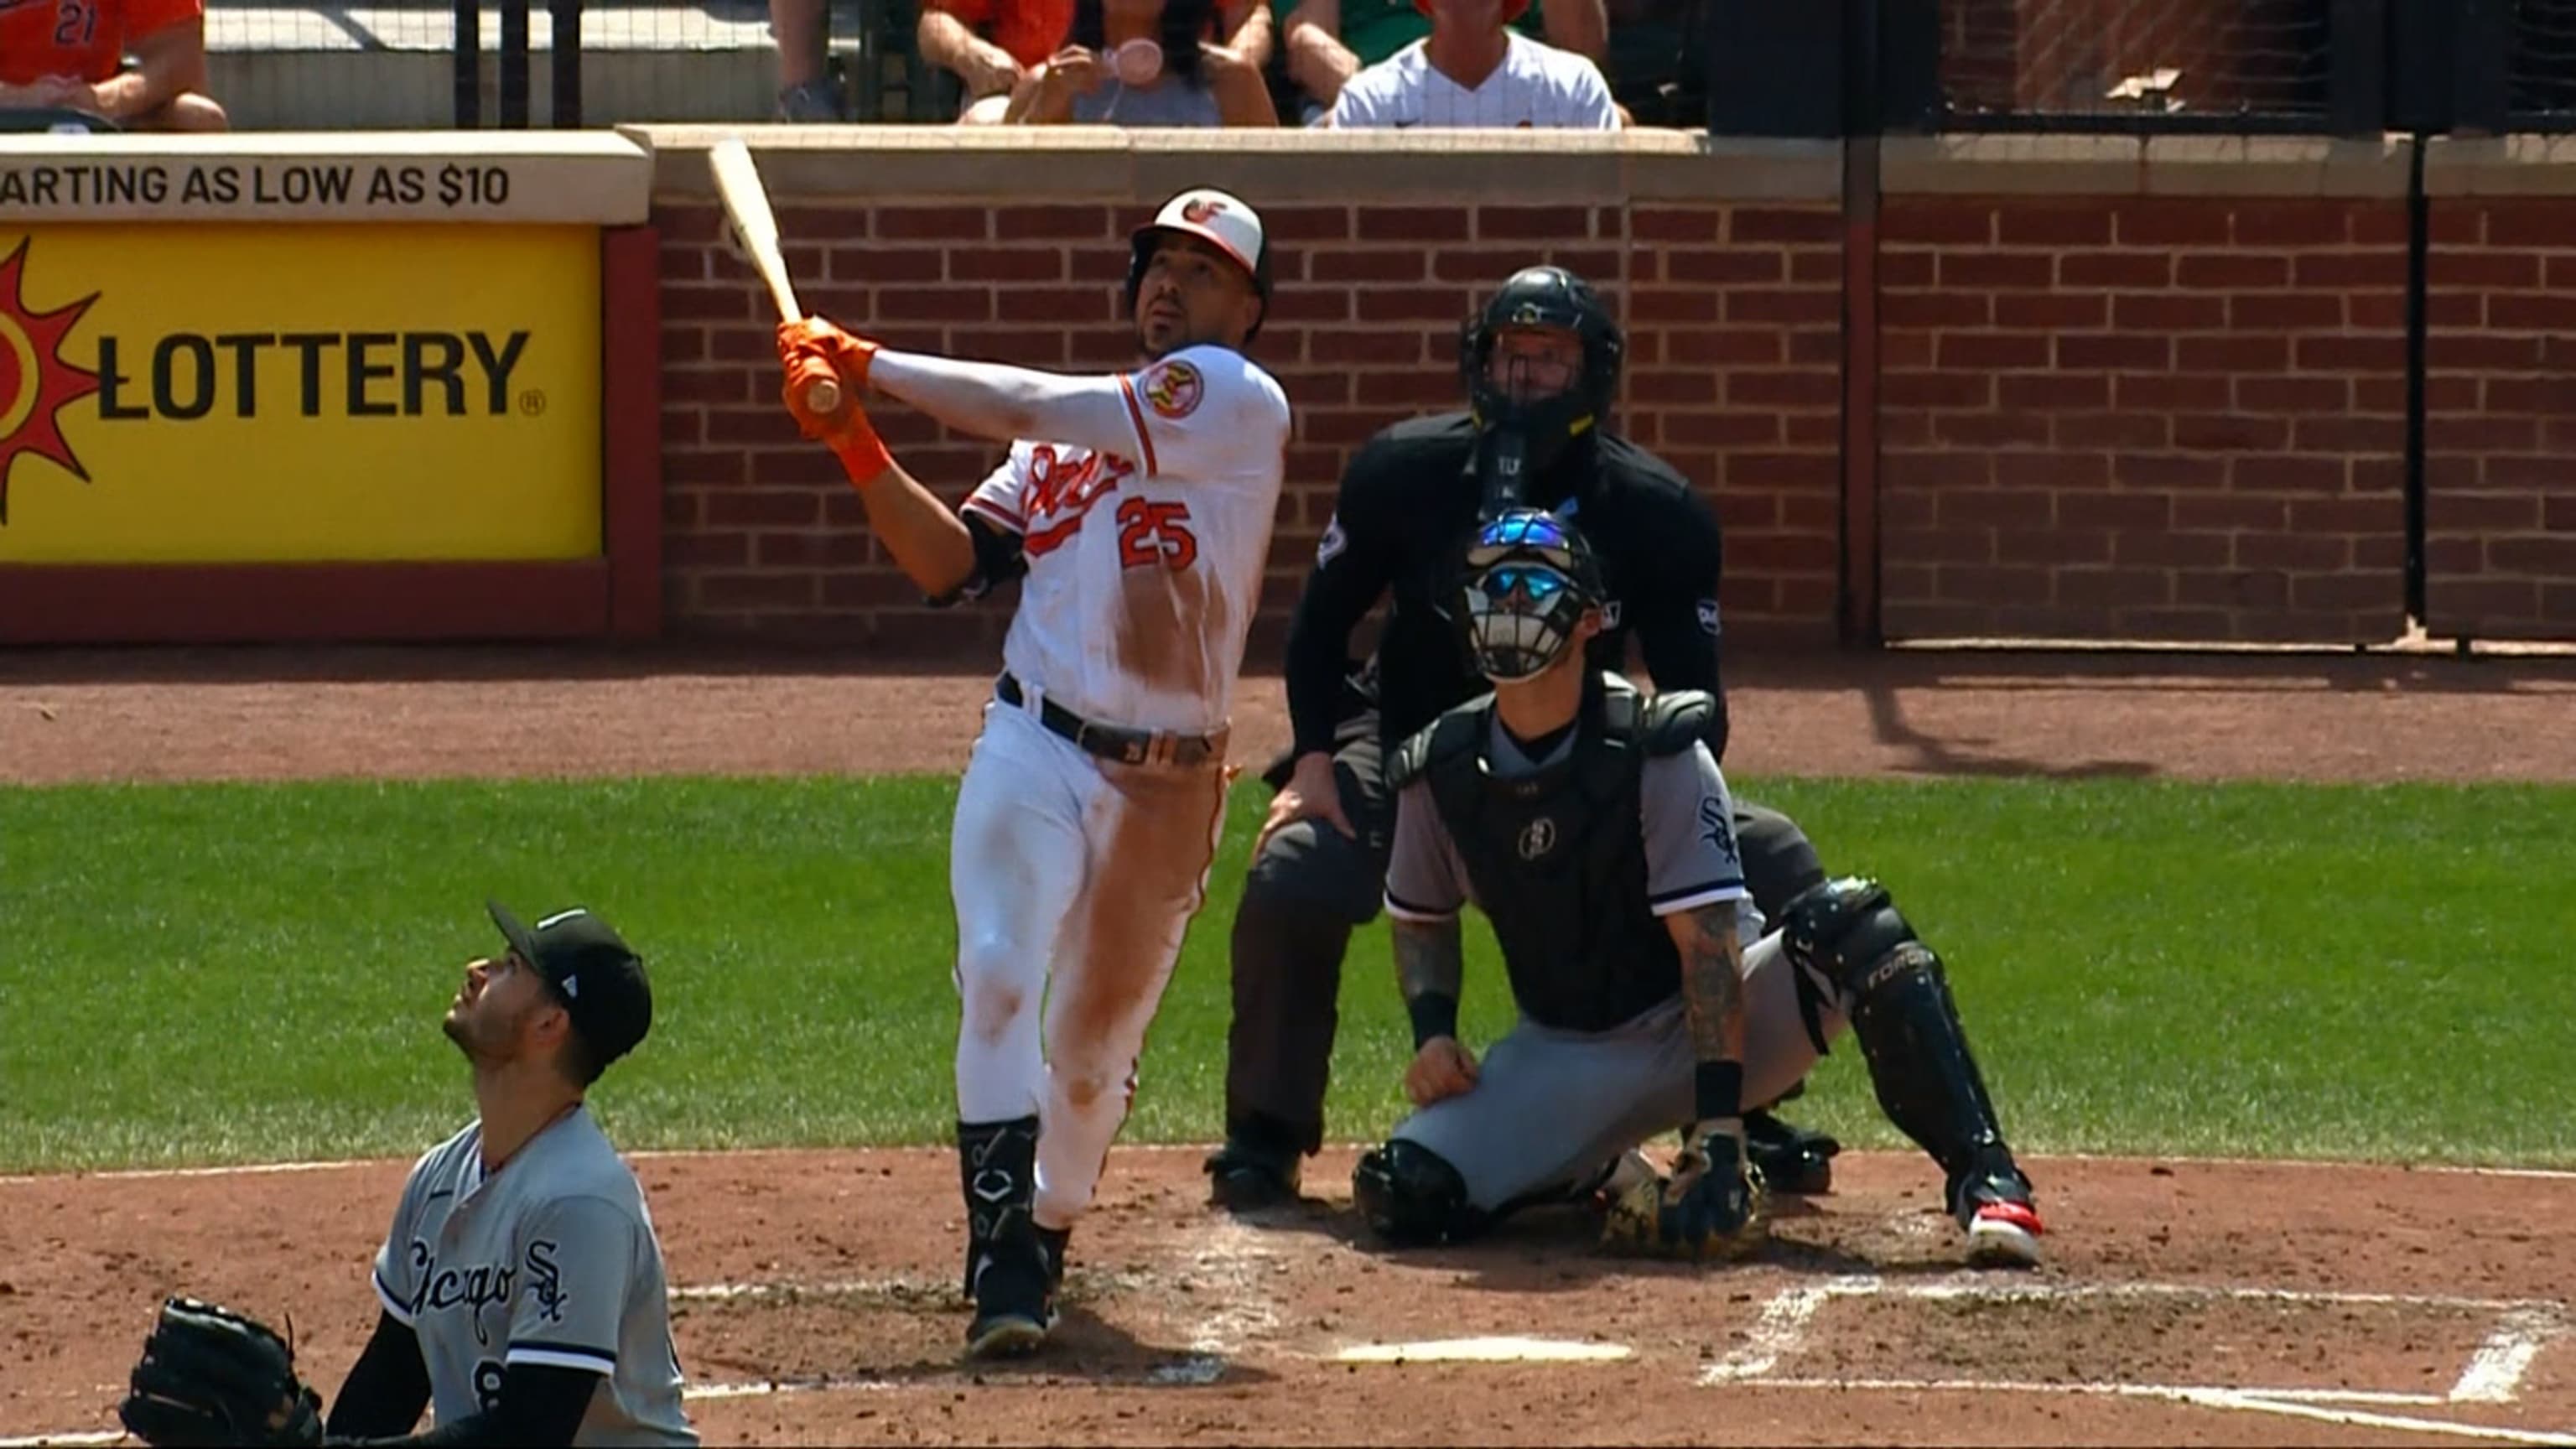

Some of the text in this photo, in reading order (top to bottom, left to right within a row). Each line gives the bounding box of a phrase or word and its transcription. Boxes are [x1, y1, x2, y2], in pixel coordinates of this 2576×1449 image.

[54, 2, 98, 47] 21
[0, 162, 509, 208] ARTING AS LOW AS $10
[1115, 496, 1197, 573] 25
[526, 1239, 569, 1322] Sox
